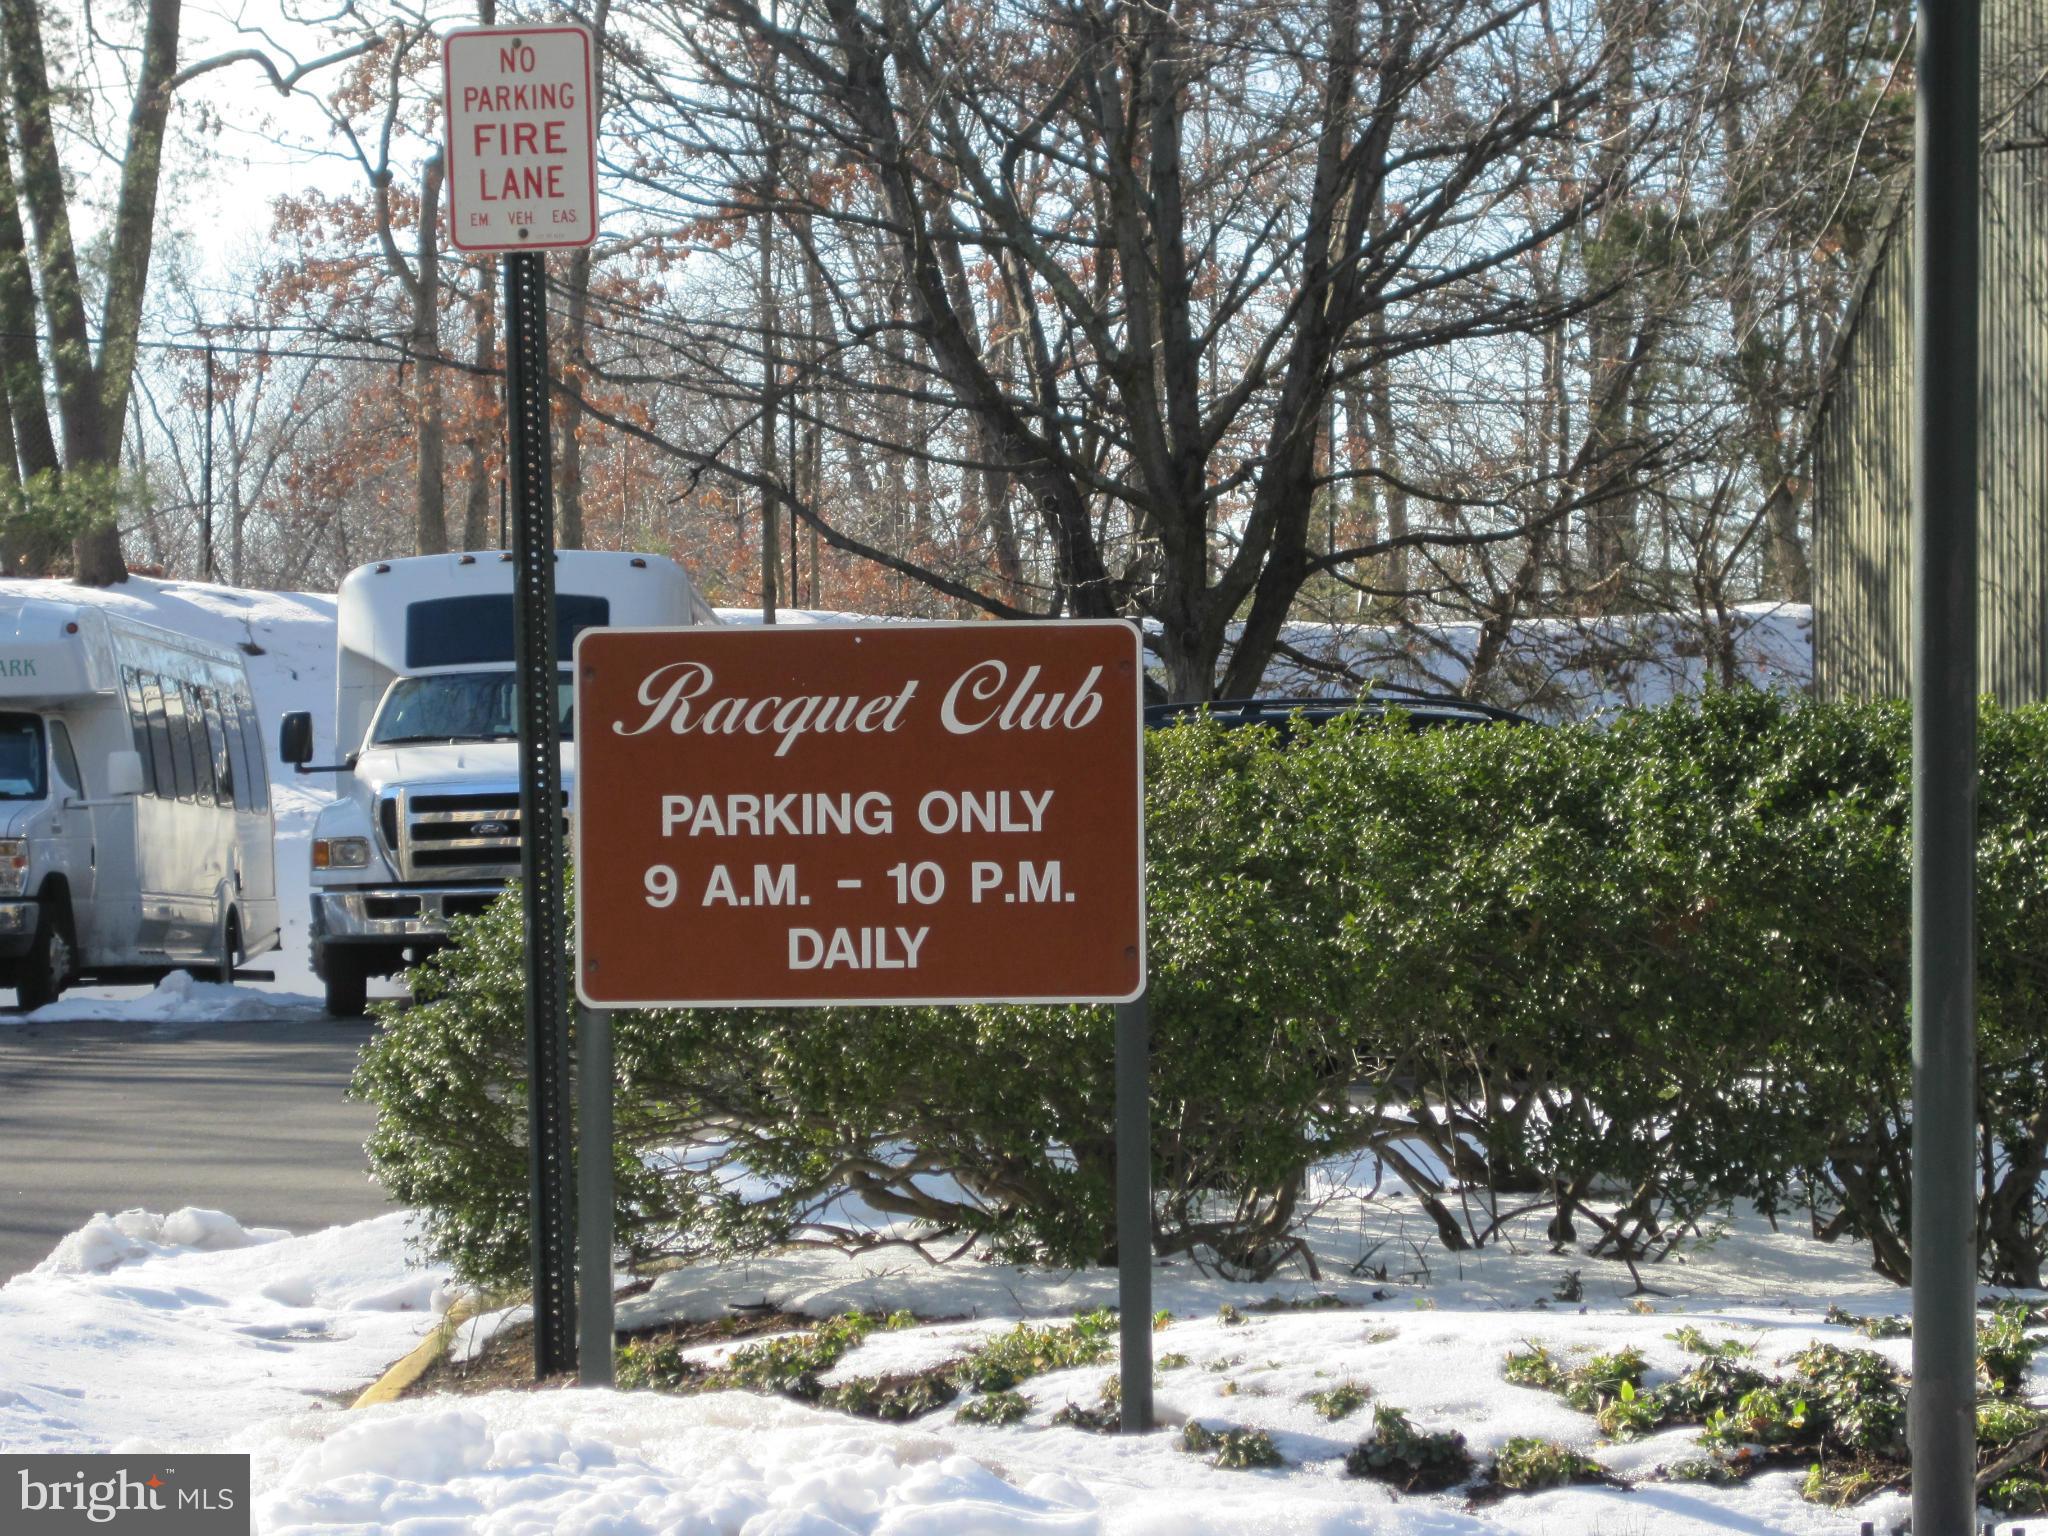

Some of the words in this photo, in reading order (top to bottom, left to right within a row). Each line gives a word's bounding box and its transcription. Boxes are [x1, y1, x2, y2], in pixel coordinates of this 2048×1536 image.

[500, 46, 536, 73] NO
[463, 82, 575, 113] PARKING
[474, 120, 568, 157] FIRE
[479, 165, 566, 201] LANE
[612, 660, 920, 758] Racquet
[939, 659, 1104, 736] Club
[661, 791, 894, 838] PARKING
[917, 789, 1055, 835] ONLY
[643, 864, 679, 909] 9
[701, 863, 811, 907] A.M.
[885, 861, 946, 905] 10
[971, 860, 1076, 904] P.M.
[787, 926, 931, 971] DAILY
